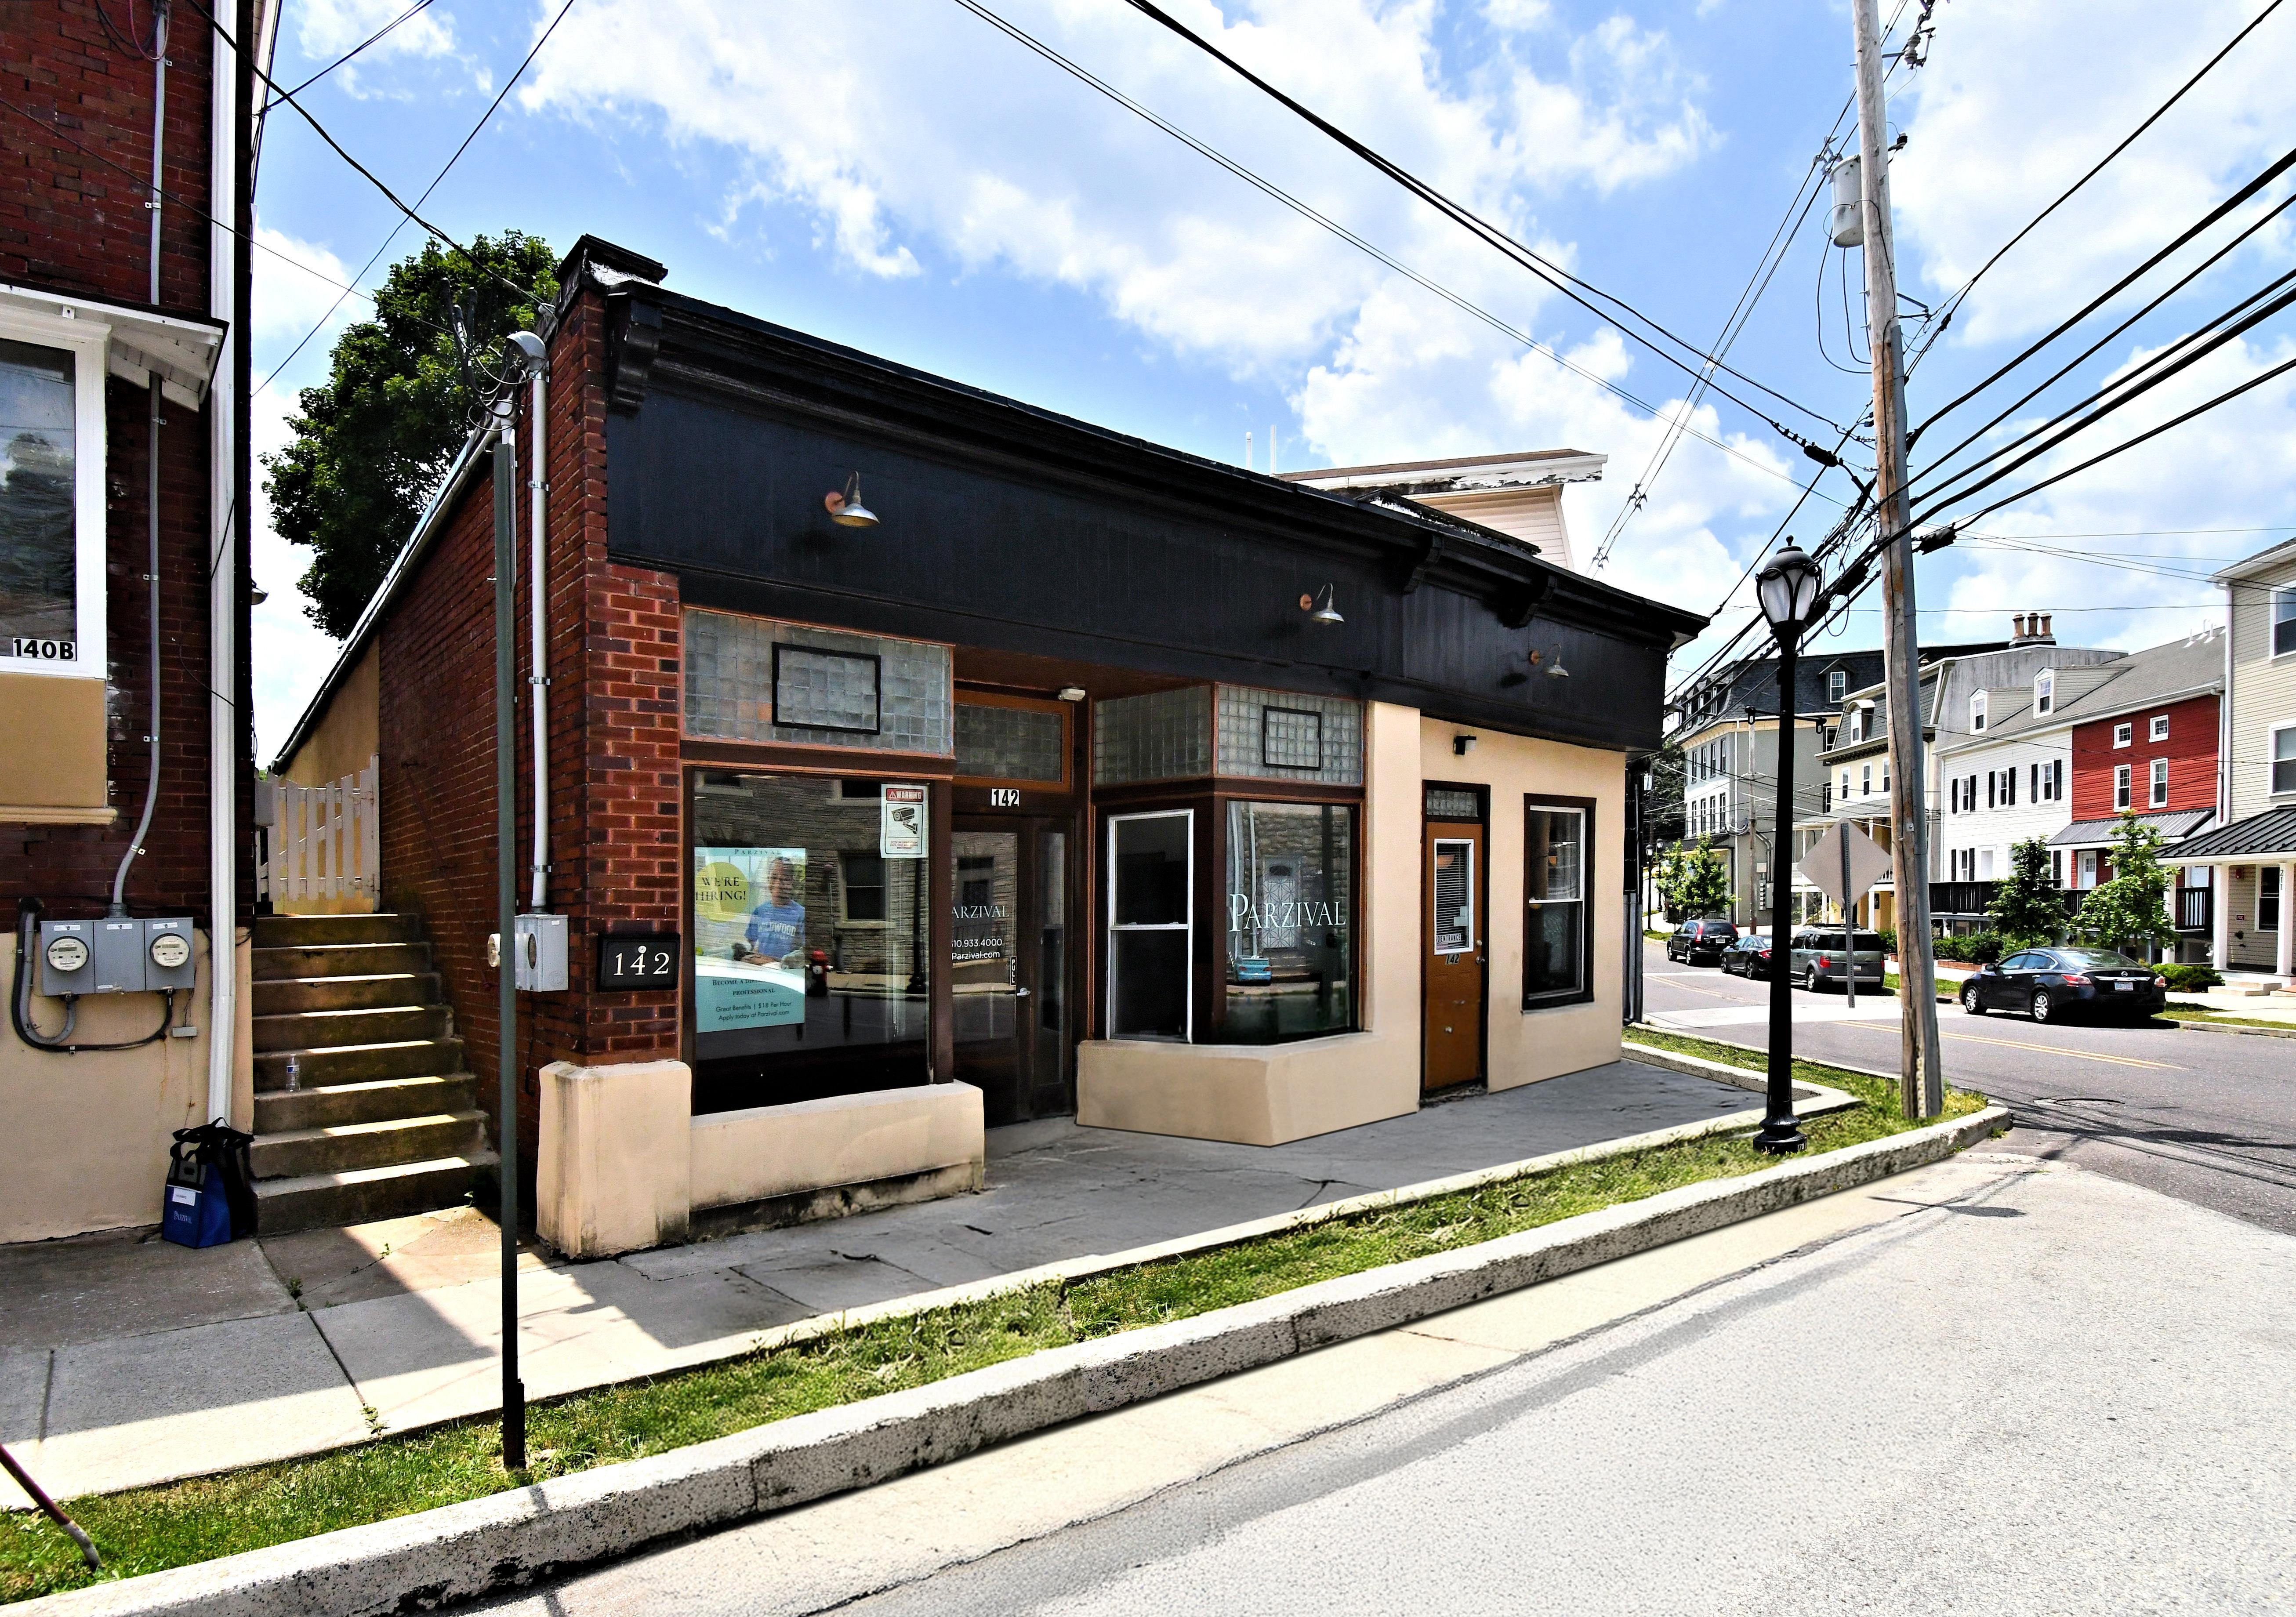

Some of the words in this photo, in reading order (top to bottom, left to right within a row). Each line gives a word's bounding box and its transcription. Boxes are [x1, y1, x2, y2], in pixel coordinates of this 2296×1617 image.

[15, 639, 74, 660] 140B
[896, 791, 921, 800] WARNING
[994, 789, 1018, 807] 142
[696, 890, 746, 901] HIRING!
[951, 905, 1010, 919] ARZIVAL
[1229, 893, 1346, 932] PARZIVAL
[952, 938, 1003, 948] 10.933.4000
[952, 951, 1000, 961] Parzival.com
[1447, 953, 1459, 964] 142
[613, 952, 670, 975] 142
